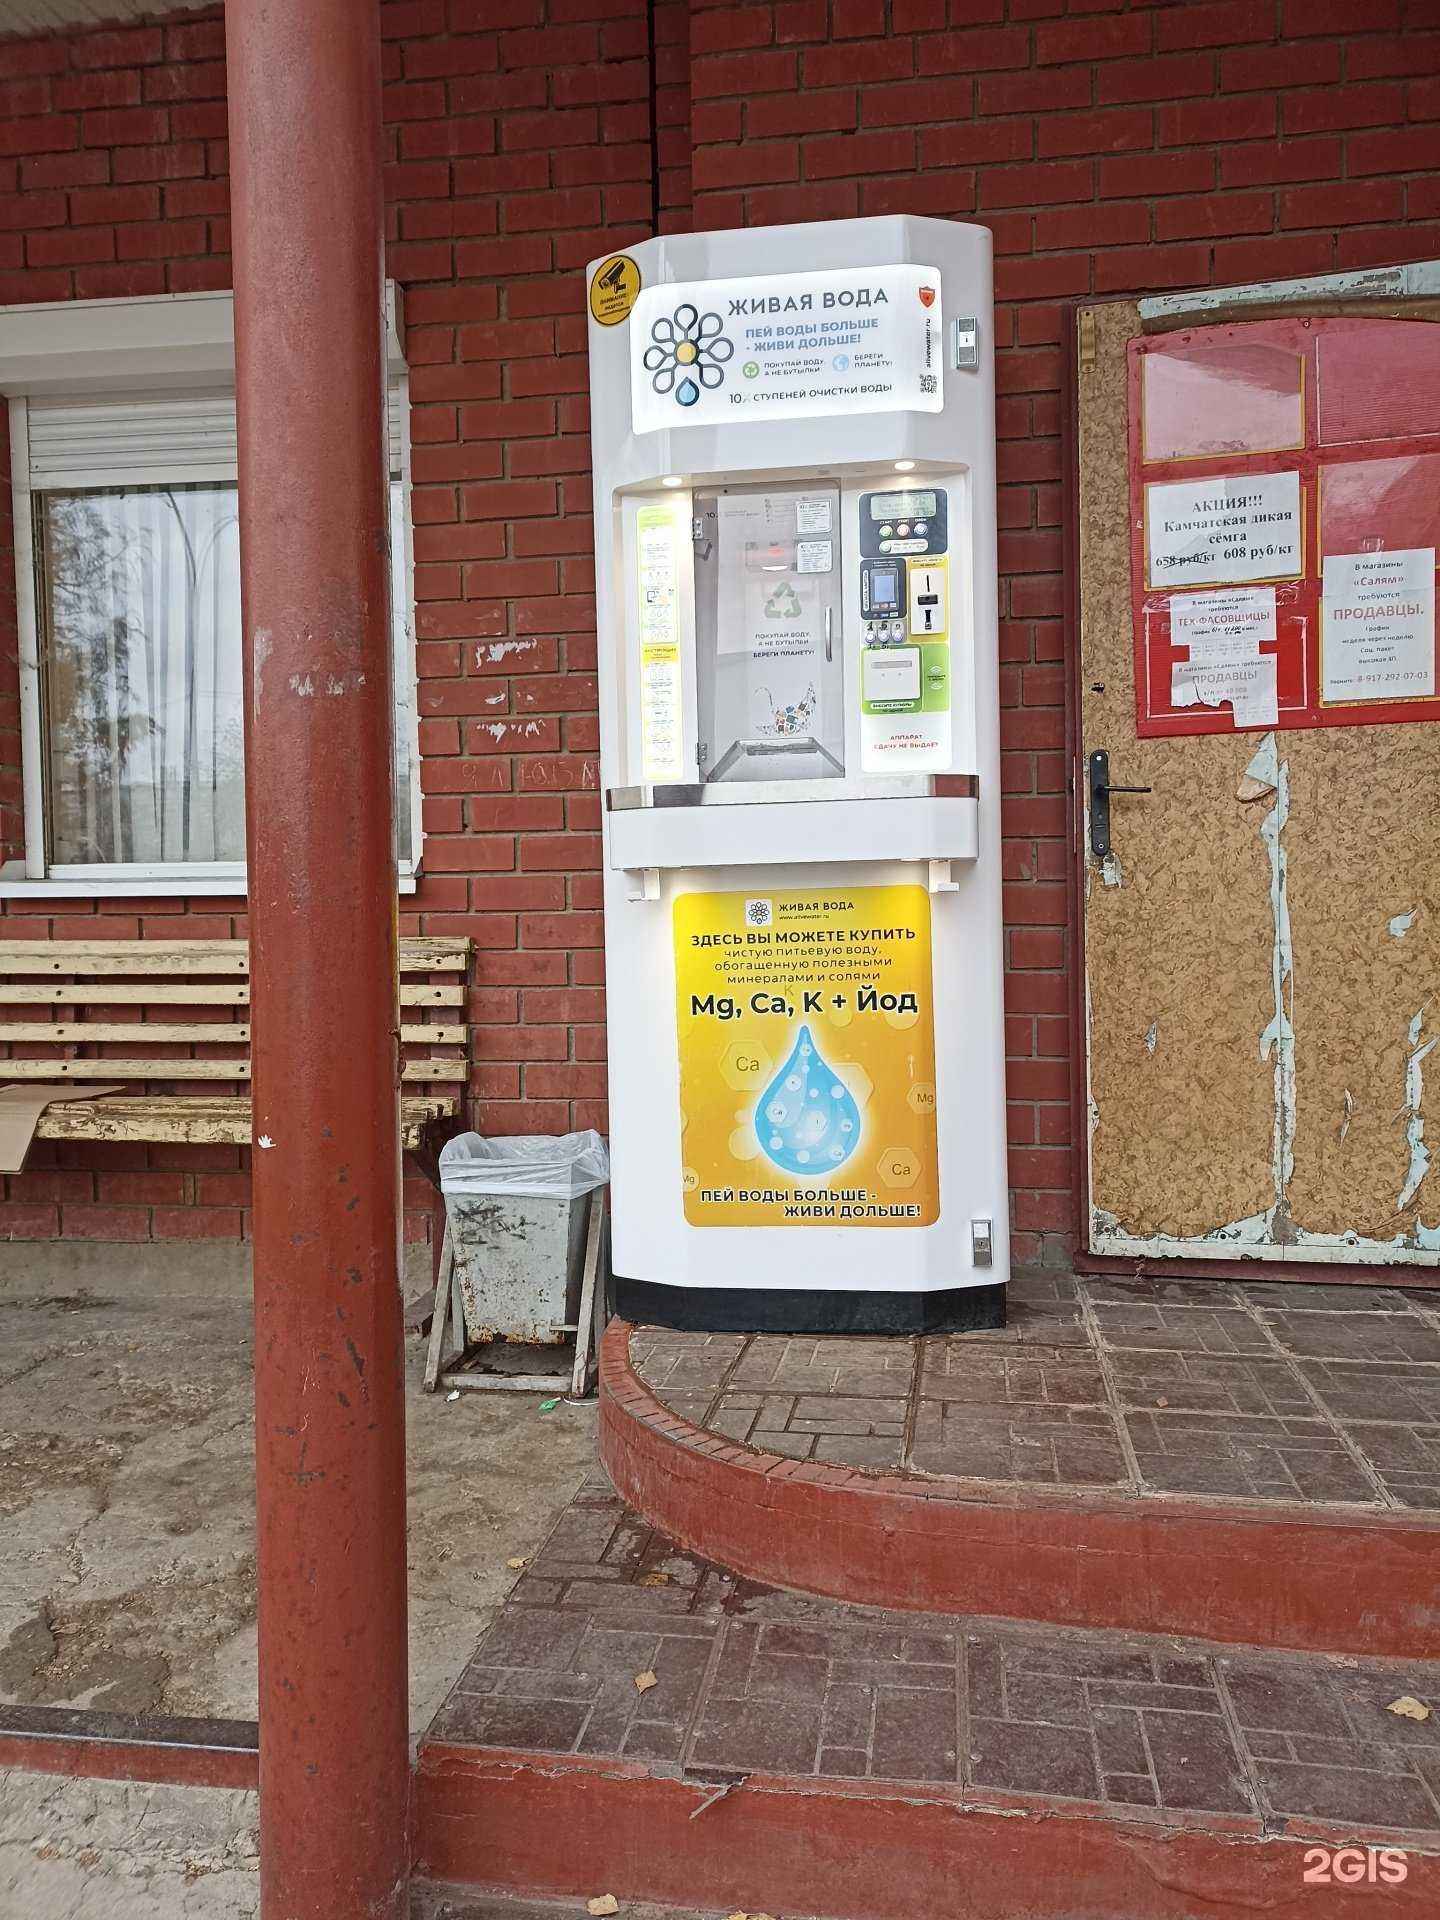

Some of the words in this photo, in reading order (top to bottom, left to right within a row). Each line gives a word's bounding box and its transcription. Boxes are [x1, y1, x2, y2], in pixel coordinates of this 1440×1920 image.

[728, 293, 813, 316] ЖИВАЯ
[823, 288, 889, 309] ВОДА
[745, 325, 773, 339] ПЕЙ
[776, 323, 817, 337] ВОДЫ
[820, 318, 880, 332] БОЛЬШЕ
[754, 339, 795, 352] ЖИВИ
[798, 333, 861, 351] ДОЛЬШЕ!
[753, 390, 807, 402] СТУПЕНЕЙ
[809, 386, 859, 398] ОЧИСТКИ
[860, 383, 893, 394] ВОДЫ
[1192, 494, 1263, 513] АКЦИЯ!!!
[1164, 515, 1247, 533] Камчатская
[1250, 511, 1292, 524] дикая
[1209, 532, 1247, 544] сёмга
[1223, 547, 1246, 559] 608
[1250, 544, 1294, 560] руб/кг
[1355, 563, 1360, 571] В
[1362, 562, 1403, 570] магазины
[1354, 577, 1404, 586] «Салям»
[1358, 592, 1400, 601] требуются
[1334, 604, 1425, 621] ПРОДАВЦЫ.
[1192, 671, 1257, 684] ПРОДАВЦЫ
[779, 903, 819, 912] ЖИВАЯ
[823, 902, 855, 911] ВОДА
[691, 934, 743, 948] ЗДЕСЬ
[747, 933, 771, 944] ВЫ
[776, 930, 845, 944] МОЖЕТЕ
[850, 928, 917, 941] КУПИТЬ
[724, 948, 773, 960] чистую
[776, 947, 843, 959] питьевую
[714, 959, 809, 972] обогащенную
[812, 957, 893, 969] полезными
[727, 973, 814, 985] минералами
[817, 973, 825, 982] и
[828, 971, 881, 982] солями
[690, 994, 742, 1020] Mg,
[750, 992, 794, 1017] Ca,
[803, 991, 823, 1013] K
[832, 994, 847, 1009] +
[857, 984, 919, 1015] Йод
[736, 1055, 760, 1072] Ca
[917, 1093, 934, 1105] Mg
[891, 1163, 912, 1176] Ca
[701, 1187, 735, 1202] ПЕЙ
[739, 1190, 789, 1203] ВОДЫ
[793, 1188, 867, 1202] БОЛЬШЕ
[784, 1205, 835, 1217] ЖИВИ
[840, 1205, 921, 1218] ДОЛЬШЕ!
